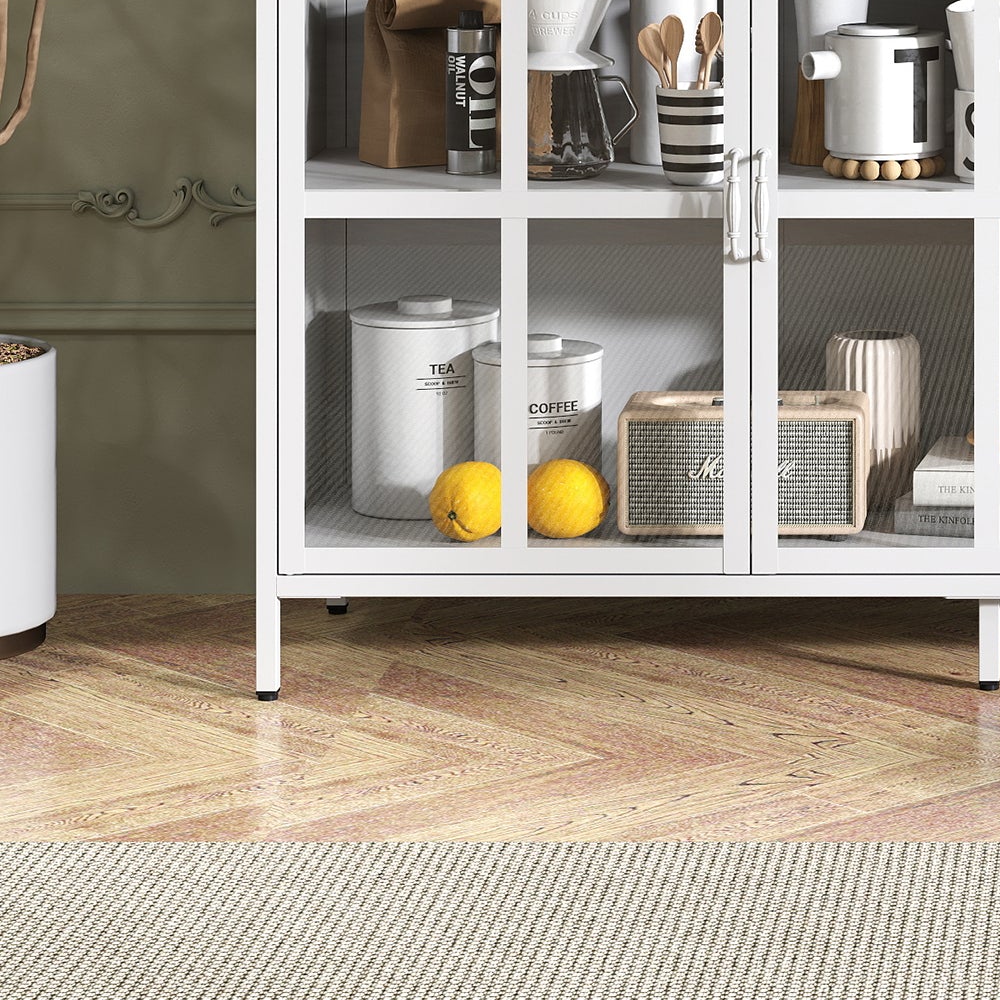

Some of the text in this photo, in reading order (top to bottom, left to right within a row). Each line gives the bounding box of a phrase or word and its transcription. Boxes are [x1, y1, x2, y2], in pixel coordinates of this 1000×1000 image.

[455, 55, 466, 107] WALNUT
[893, 45, 939, 143] T
[469, 55, 497, 149] OIL
[429, 363, 455, 375] TEA
[529, 400, 578, 414] COFFEE
[938, 485, 957, 494] THE
[918, 514, 974, 525] THE KINFOL
